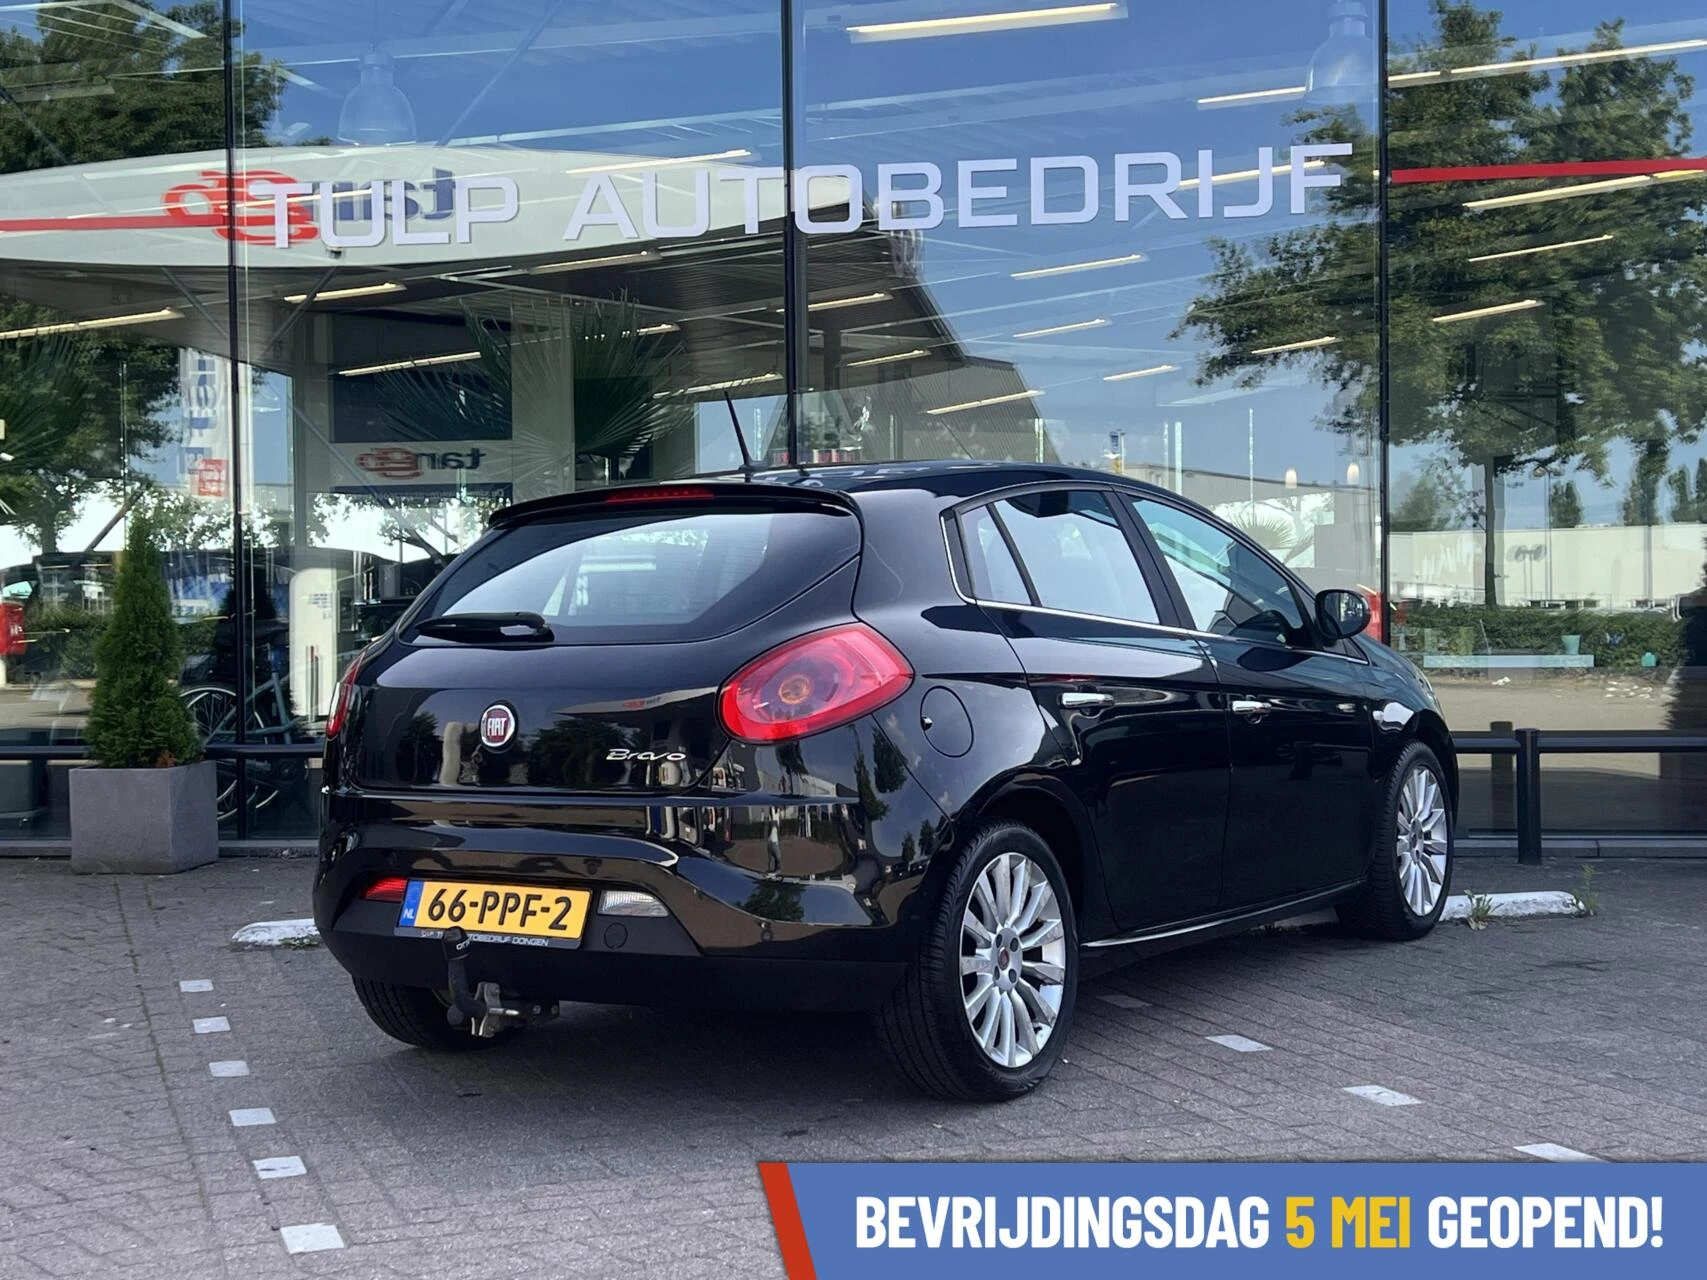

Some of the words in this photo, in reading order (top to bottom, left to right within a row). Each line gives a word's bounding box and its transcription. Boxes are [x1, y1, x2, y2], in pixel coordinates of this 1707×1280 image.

[250, 176, 520, 249] TULP
[562, 143, 1353, 241] AUTOBEDRIJF
[487, 717, 507, 737] FIAT
[606, 748, 686, 760] Bravo
[403, 908, 415, 920] NL
[427, 888, 572, 931] 66-PPF-2
[511, 936, 549, 946] DONGEN
